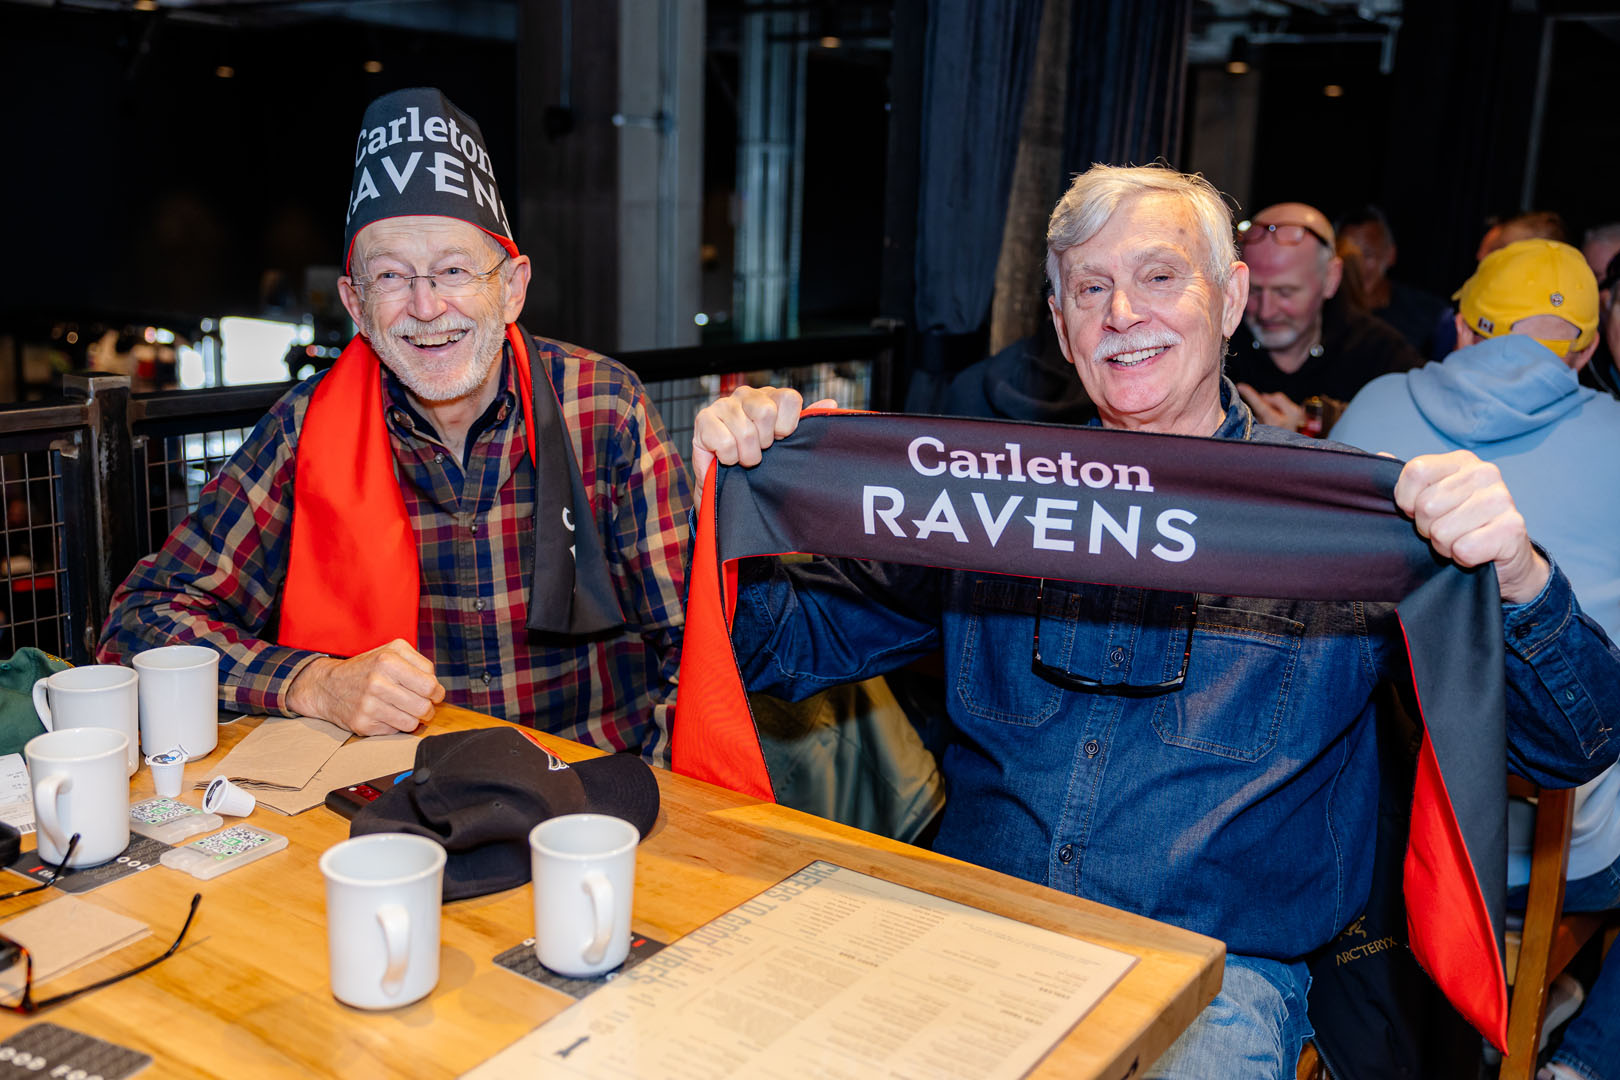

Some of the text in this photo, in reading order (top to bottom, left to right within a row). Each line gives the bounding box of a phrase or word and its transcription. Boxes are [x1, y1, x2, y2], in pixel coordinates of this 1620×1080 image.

[355, 106, 496, 182] Carleton
[346, 151, 513, 242] AVEN
[907, 436, 1154, 493] Carleton
[862, 485, 1199, 563] RAVENS
[764, 861, 841, 902] CHEERS
[694, 915, 752, 946] GOOD
[739, 903, 778, 917] TO
[625, 943, 702, 986] VIBES
